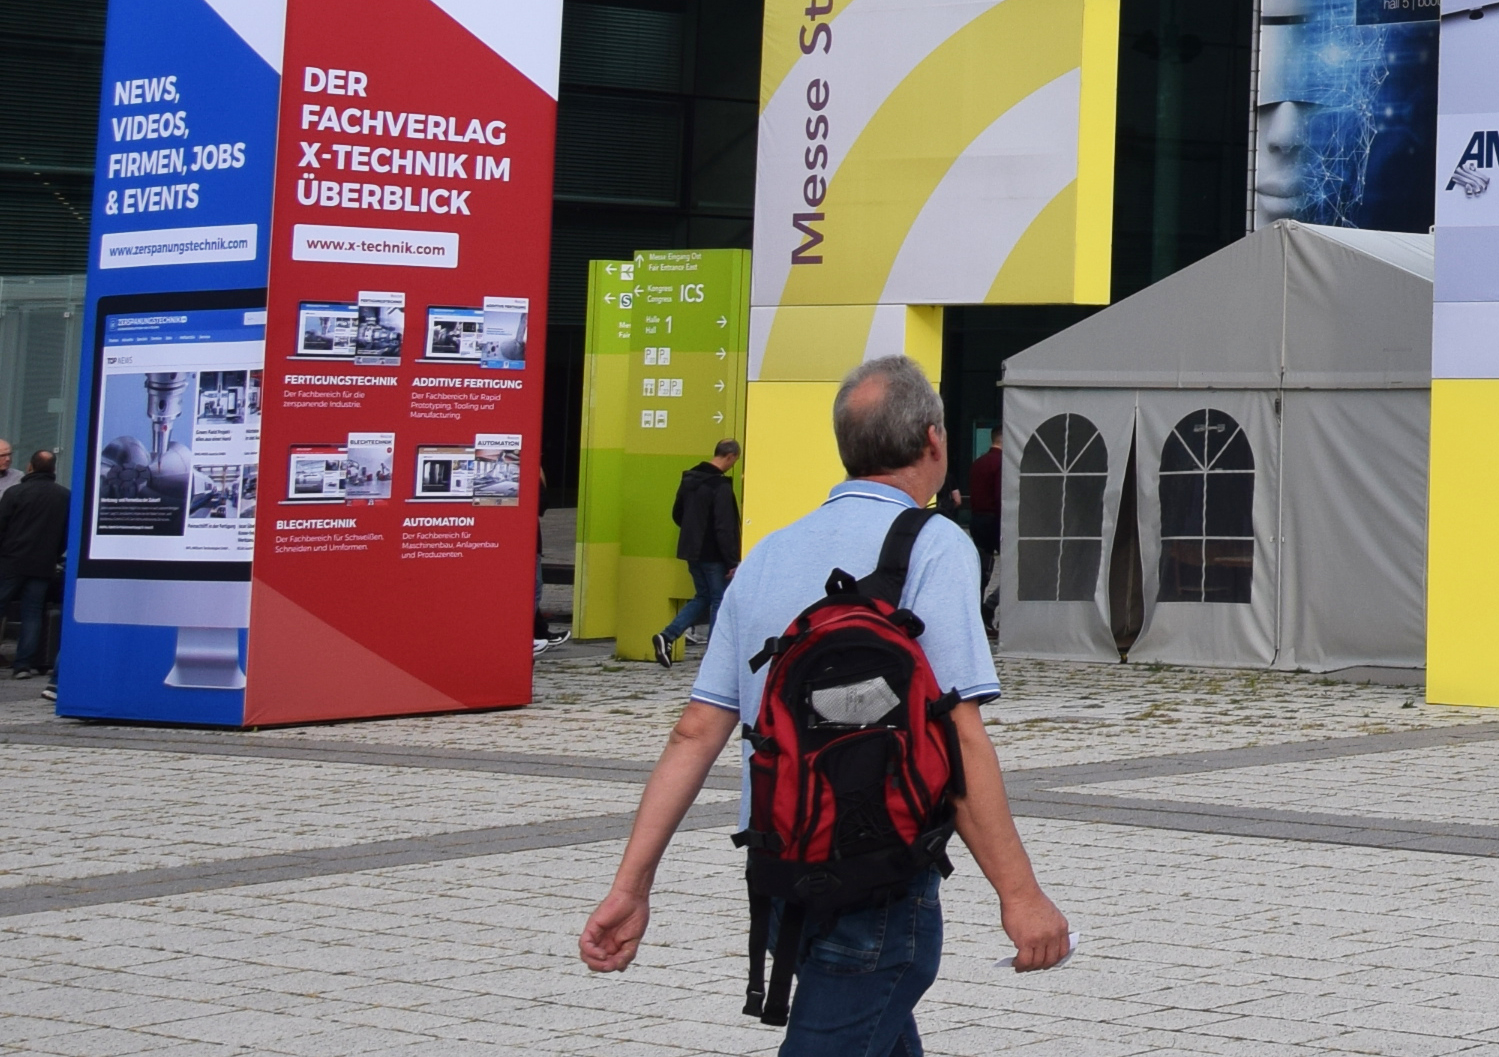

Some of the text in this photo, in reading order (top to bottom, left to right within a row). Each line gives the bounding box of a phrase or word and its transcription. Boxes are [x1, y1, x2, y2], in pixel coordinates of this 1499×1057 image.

[114, 76, 180, 106] NEWS,
[304, 67, 368, 98] DER
[113, 111, 189, 141] VIDEOS,
[302, 104, 507, 146] FACHVERLAG
[109, 142, 246, 178] FIRMEN, JOBS
[298, 142, 511, 182] X-TECHNIK IM
[790, 78, 832, 266] Messe
[105, 183, 199, 215] & EVENTS
[297, 173, 471, 216] ÜBERBLICK
[109, 237, 248, 258] www.zerspanungstechnik.com
[306, 237, 446, 257] www.x-technik.com
[680, 283, 704, 303] ICS
[646, 315, 660, 323] Halle
[666, 315, 672, 333] 1
[284, 375, 398, 387] FERTIGUNGSTECHNIK
[412, 377, 523, 389] ADDITIVE FERTIGUNG
[284, 390, 298, 399] Der
[298, 390, 340, 399] Fachbereich
[412, 392, 424, 400] Der
[426, 393, 468, 401] Fachbereich
[480, 393, 502, 403] Rapid
[276, 518, 356, 530] BLECHTECHNIK
[402, 517, 474, 527] AUTOMATION
[276, 535, 288, 543] Der
[290, 534, 332, 543] Fachbereich
[402, 532, 415, 540] Der
[416, 531, 459, 540] Fachbereich
[275, 545, 312, 553] Schneiden
